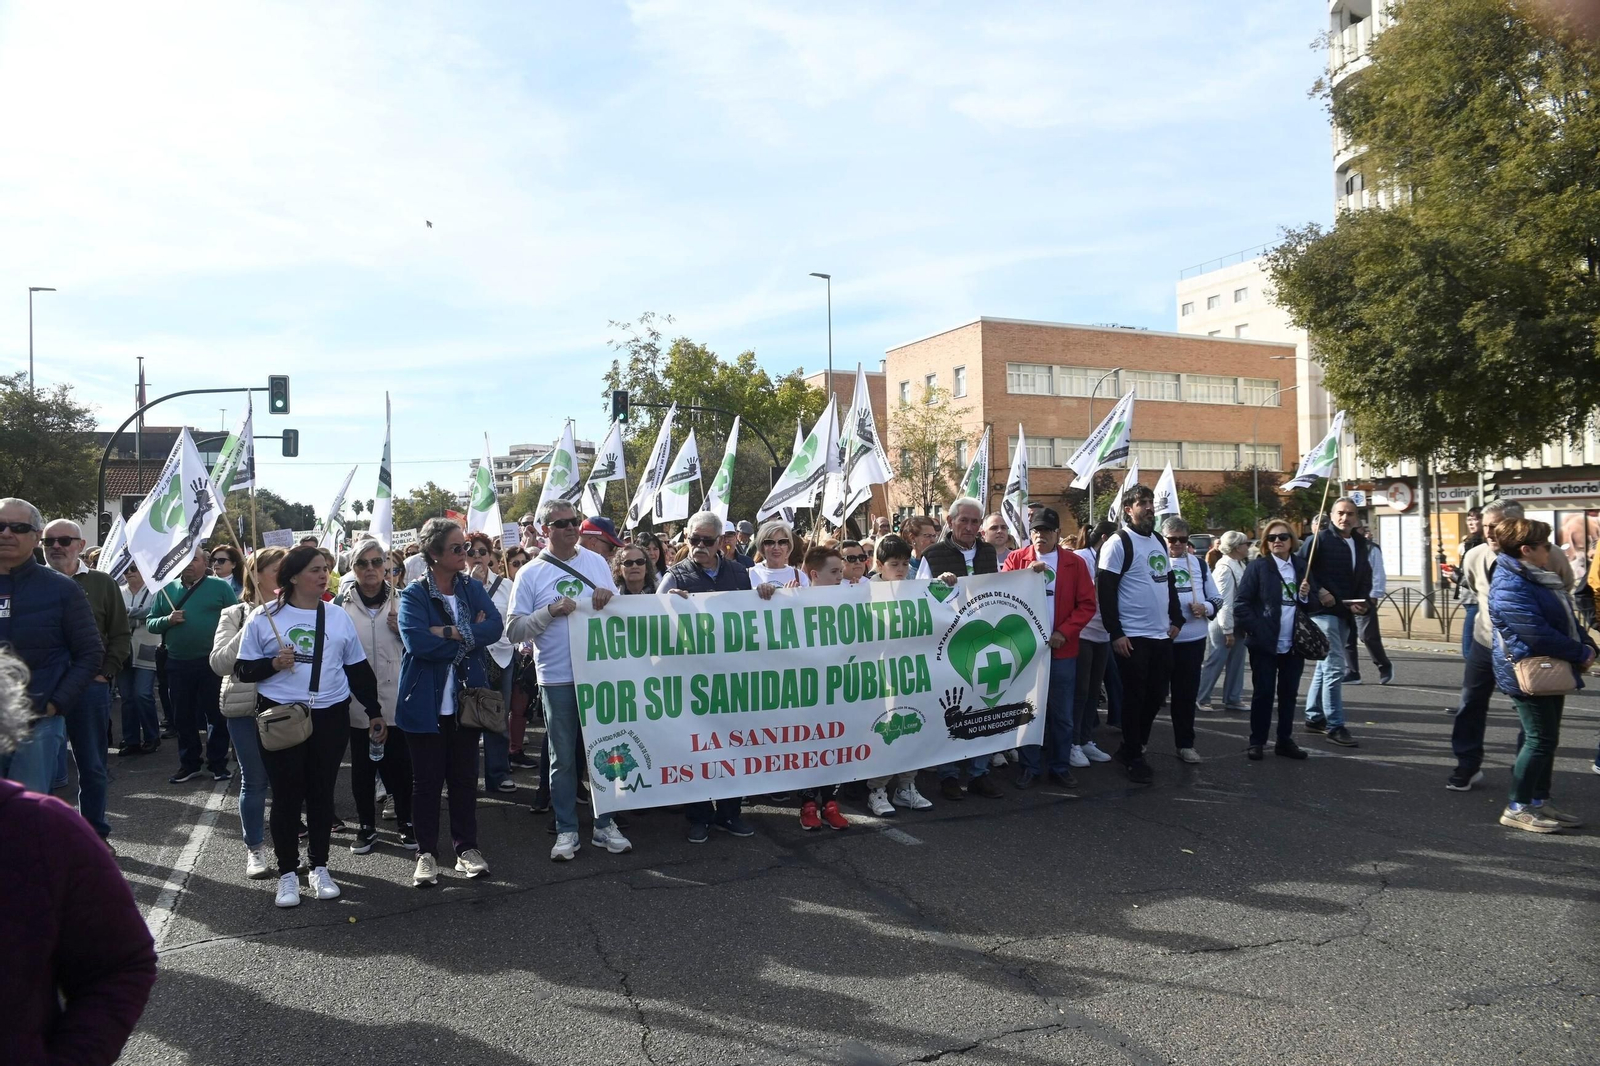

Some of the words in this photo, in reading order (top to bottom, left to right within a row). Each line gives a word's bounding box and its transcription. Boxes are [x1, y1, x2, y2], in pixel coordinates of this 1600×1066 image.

[936, 615, 961, 661] PLATAFORMA
[958, 606, 968, 616] EN
[966, 592, 993, 608] DEFENSA
[1011, 595, 1034, 617] SANIDAD
[1032, 615, 1050, 646] PÚBLICA
[966, 603, 985, 618] AGUILAR
[996, 599, 1018, 610] FRONTERA
[587, 613, 716, 662] AGUILAR
[722, 610, 760, 653] DE
[763, 608, 800, 651] LA
[803, 598, 934, 648] FRONTERA
[577, 680, 638, 727] POR
[643, 675, 683, 721] SU
[690, 668, 818, 716] SANIDAD
[826, 654, 932, 705] PÚBLICA
[690, 731, 724, 753] LA
[728, 721, 845, 748] SANIDAD
[963, 717, 983, 727] SALUD
[983, 714, 992, 722] ES
[992, 712, 1001, 720] UN
[968, 726, 978, 734] NO
[978, 724, 987, 732] UN
[659, 764, 694, 785] ES
[700, 758, 736, 779] UN
[743, 744, 871, 775] DERECHO
